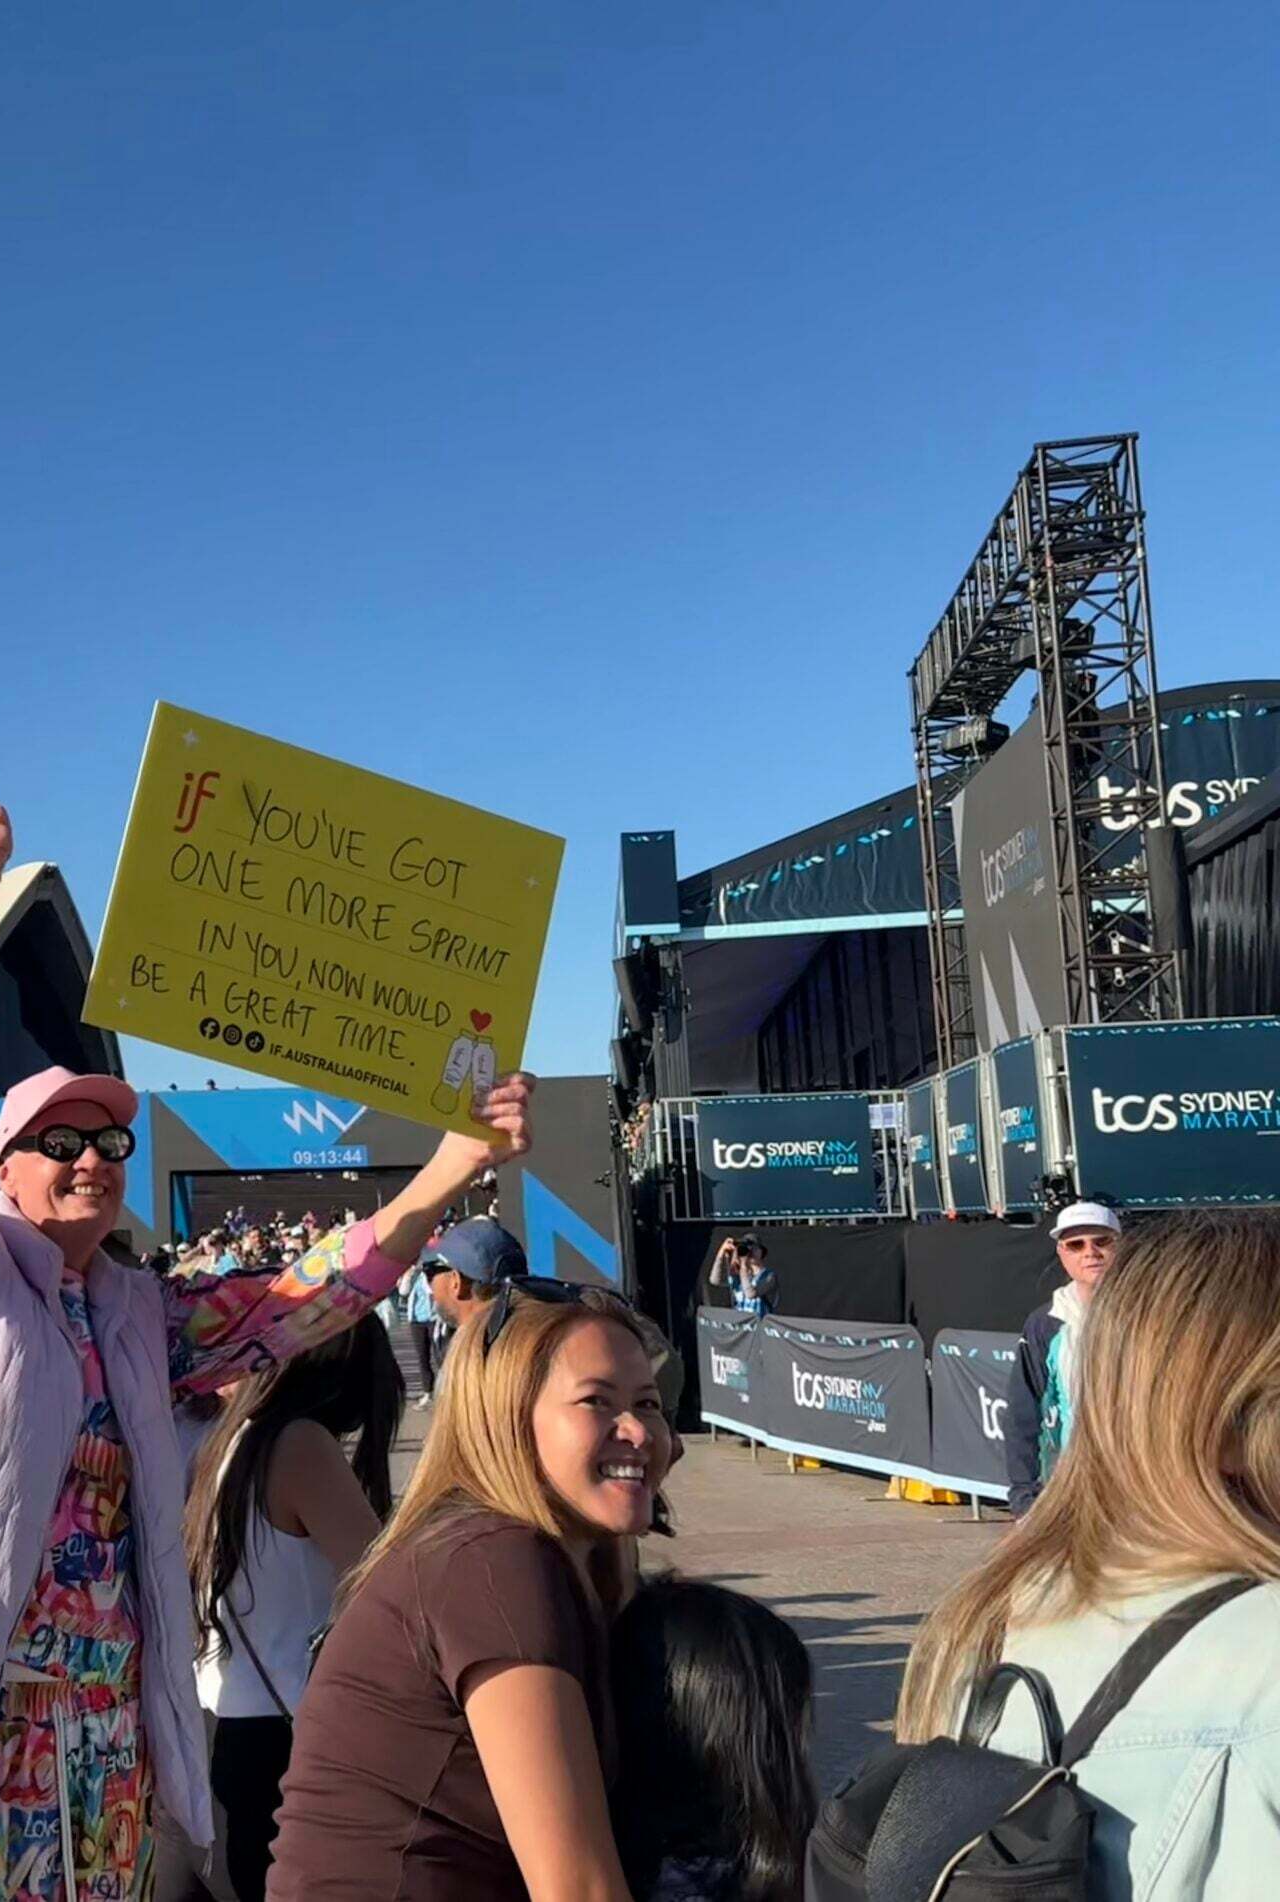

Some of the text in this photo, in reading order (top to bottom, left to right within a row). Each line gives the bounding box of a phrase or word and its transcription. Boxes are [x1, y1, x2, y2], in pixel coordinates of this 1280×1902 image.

[174, 772, 468, 899] if YOU'VE GOT
[980, 849, 1005, 907] tcs
[170, 843, 510, 979] ONE MORE SPRINT
[198, 919, 236, 953] IN
[308, 958, 366, 999] NOW
[372, 975, 451, 1028] WOULD
[131, 954, 170, 993] BE
[189, 970, 207, 1005] A
[224, 981, 317, 1037] GREAT
[334, 1014, 416, 1067] TIME.
[269, 1043, 410, 1096] IF.AUSTRALIAOFFICIAL
[1092, 1087, 1274, 1133] tcs SYDNEY
[293, 1149, 362, 1165] 09:13:44
[713, 1138, 825, 1170] tcs SYDNEY
[768, 1153, 858, 1167] MARATHON
[792, 1361, 824, 1410] tcs
[824, 1375, 861, 1399] SYDNEY
[826, 1394, 885, 1419] MARATHON
[978, 1386, 1009, 1440] tc
